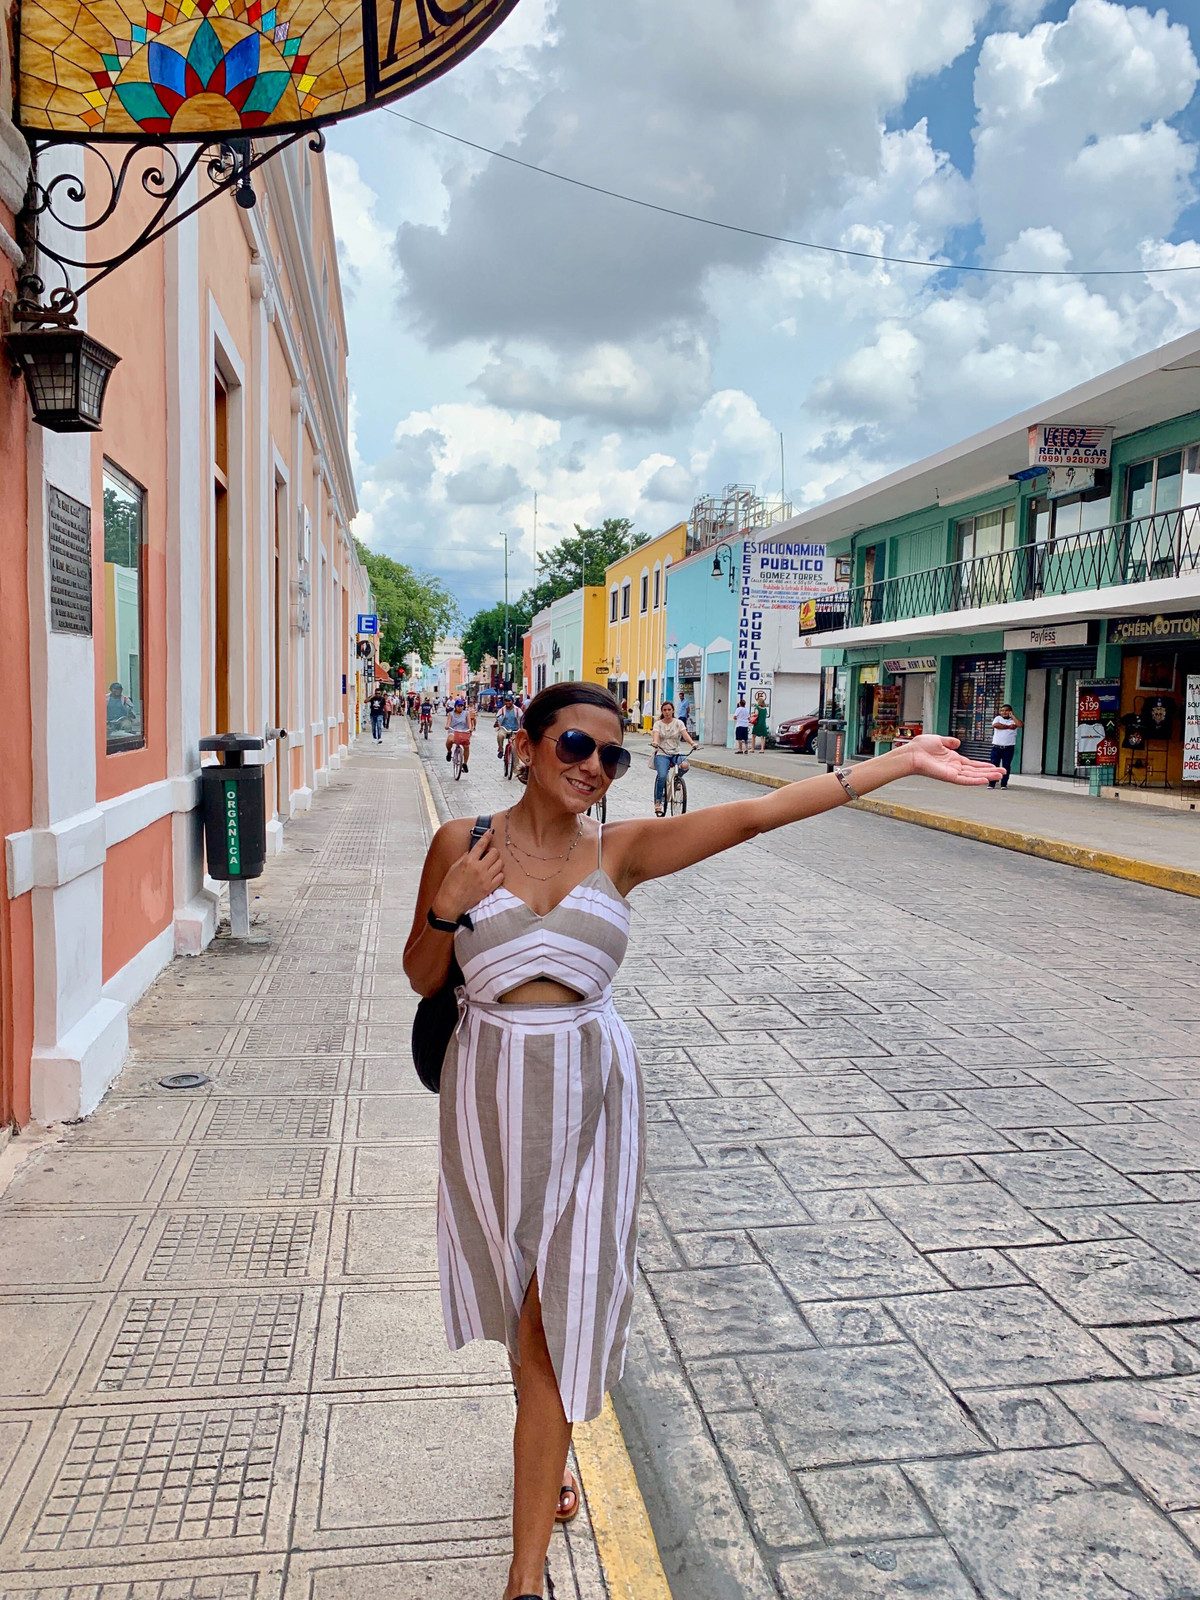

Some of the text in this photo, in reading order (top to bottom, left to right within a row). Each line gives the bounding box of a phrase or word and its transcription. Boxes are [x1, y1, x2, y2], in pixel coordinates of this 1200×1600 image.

[1043, 427, 1098, 448] VELOZ
[1039, 447, 1107, 457] RENT A CAR
[1038, 455, 1107, 465] (999) 9280373
[760, 558, 824, 572] PUBLICO
[760, 572, 823, 581] GOMEZ TORRES
[361, 617, 374, 631] E
[1154, 617, 1200, 636] COTTON
[1030, 628, 1056, 645] Payless
[749, 611, 763, 681] PUBLICO
[1080, 702, 1099, 711] $199
[1097, 747, 1118, 756] $189
[226, 791, 239, 864] ORGANICA
